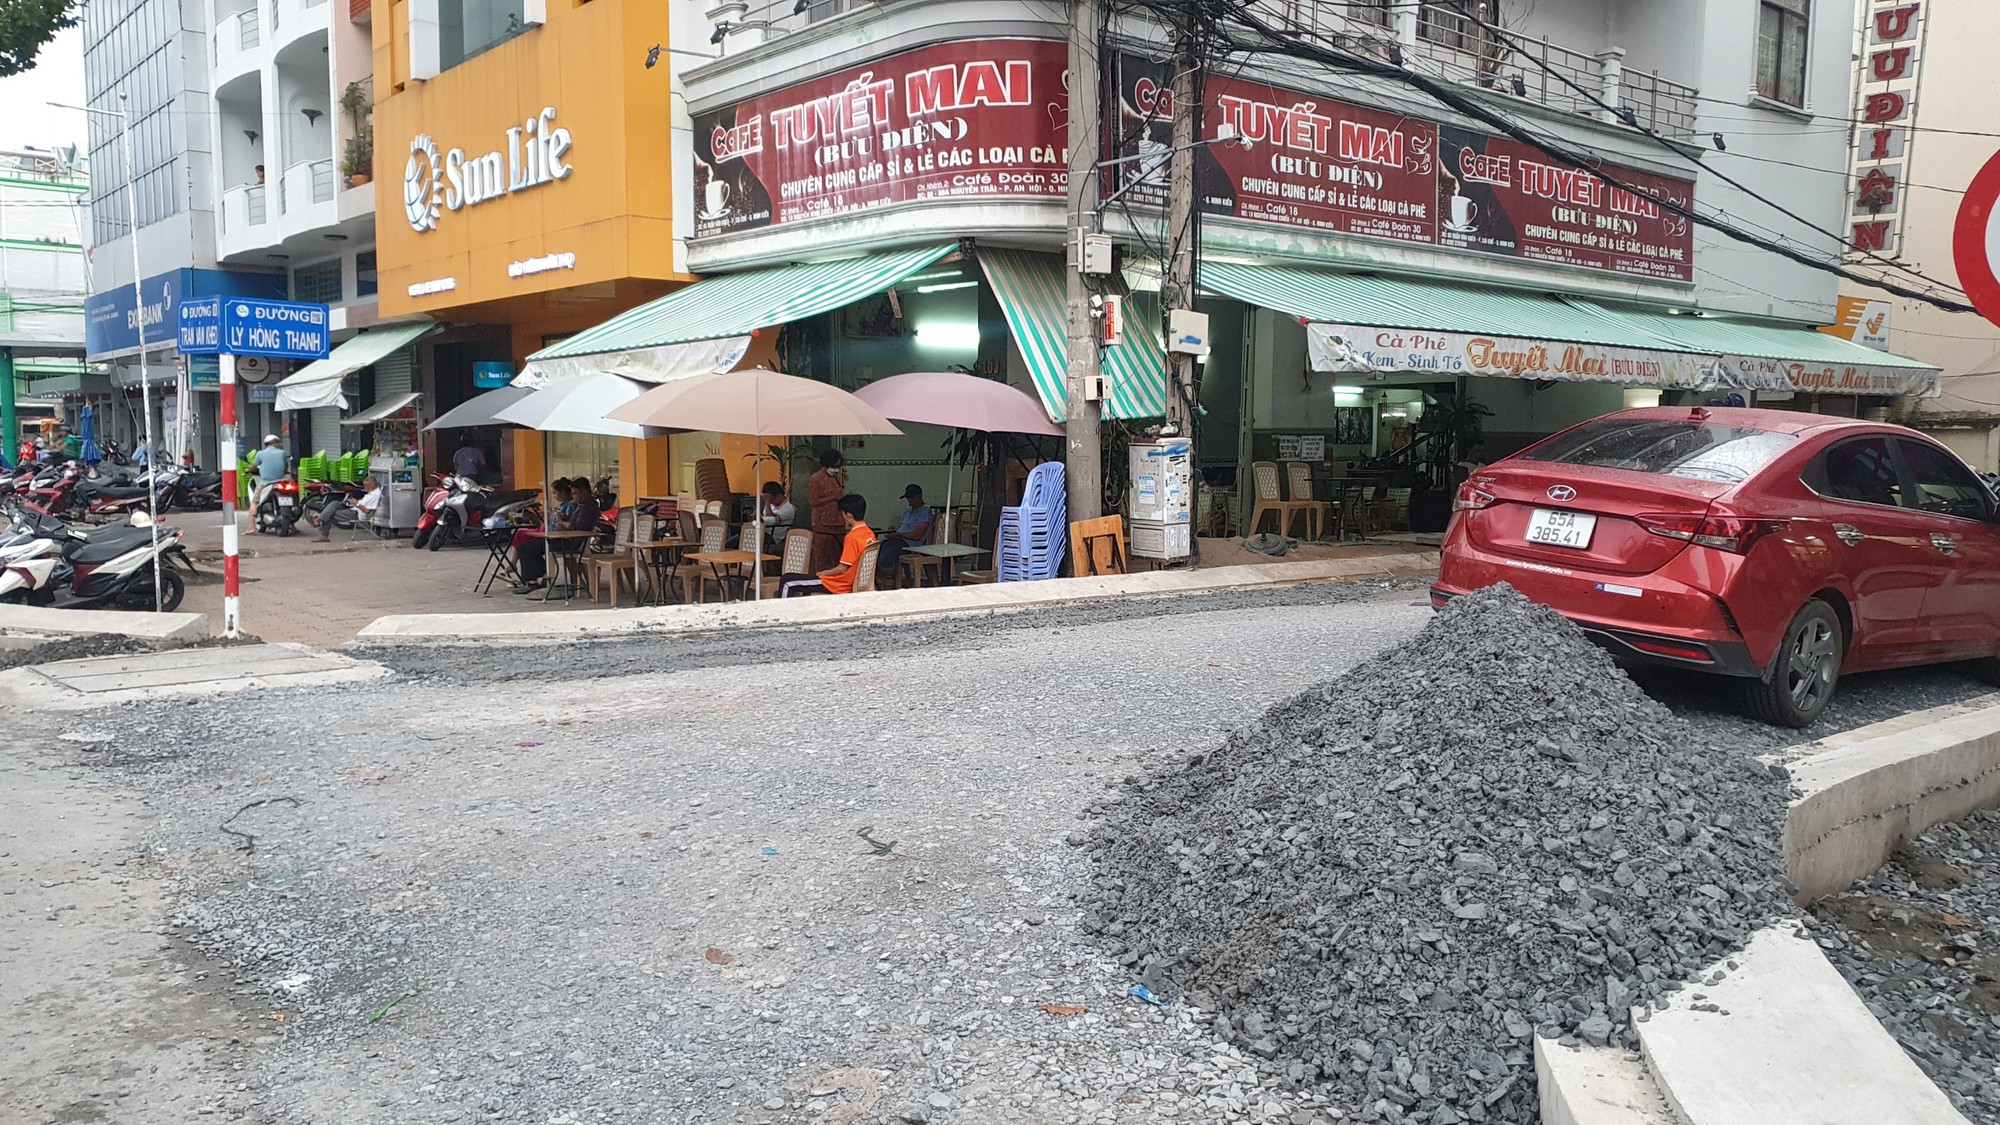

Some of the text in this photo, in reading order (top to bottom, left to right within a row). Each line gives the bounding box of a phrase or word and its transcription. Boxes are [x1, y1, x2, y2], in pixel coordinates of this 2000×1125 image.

[770, 72, 894, 148] TUYẾT
[906, 60, 1032, 117] MAI
[1218, 94, 1331, 154] TUYẾT
[1340, 120, 1403, 168] MAI
[814, 116, 968, 168] (BƯU ĐIỆN)
[446, 106, 573, 211] Sun Life
[781, 173, 822, 198] CHUYÊN
[825, 170, 855, 191] CUNG
[859, 159, 883, 181] CẤP
[887, 155, 900, 177] SỈ
[904, 157, 914, 174] &
[918, 148, 934, 172] LẺ
[937, 147, 973, 168] CÁC
[979, 146, 1023, 167] LOẠI
[1030, 144, 1057, 164] CÀ
[953, 173, 992, 185] Café
[998, 172, 1045, 184] Đoàn
[1050, 174, 1068, 184] 30
[1271, 152, 1383, 191] (BƯU ĐIỆN)
[807, 198, 830, 211] Café
[833, 195, 843, 206] 18
[1242, 176, 1278, 196] CHUYÊN
[1281, 182, 1305, 200] CUNG
[1308, 184, 1325, 204] CẤP
[1339, 192, 1345, 206] &
[1347, 189, 1358, 209] LẺ
[1359, 195, 1376, 213] CÁC
[1378, 200, 1396, 218] LOẠI
[1397, 200, 1409, 217] CÀ
[1411, 200, 1426, 219] PHÊ
[1266, 202, 1286, 215] Café
[1290, 206, 1298, 216] 18
[1372, 218, 1390, 231] Café
[1392, 220, 1412, 233] Đoàn
[1413, 224, 1421, 234] 30
[1552, 205, 1637, 235] (BƯU ĐIỆN)
[1525, 222, 1557, 240] CHUYÊN
[1559, 230, 1581, 244] CUNG
[1582, 231, 1598, 247] CẤP
[1609, 237, 1615, 249] &
[1616, 236, 1625, 251] LẺ
[1627, 240, 1640, 255] CÁC
[1642, 244, 1658, 259] LOẠI
[1659, 244, 1669, 259] CÀ
[1670, 245, 1684, 261] PHÊ
[1545, 245, 1563, 256] Café
[1565, 248, 1572, 257] 18
[1634, 258, 1649, 271] Café
[189, 303, 211, 318] ĐƯỜNG
[255, 304, 310, 322] ĐƯỜNG
[180, 321, 194, 345] TRẦN
[231, 321, 320, 351] LÝ HỒNG THANH
[1375, 333, 1448, 351] Cà Phê
[1363, 351, 1397, 368] Kem
[1407, 353, 1440, 370] Sinh
[1442, 353, 1463, 371] Tố
[1466, 338, 1549, 376] Tuyết
[1552, 344, 1610, 376] Mai
[1740, 360, 1755, 372] Cà
[1788, 363, 1835, 391] Tuyết
[1837, 367, 1870, 389] Mai
[252, 388, 275, 399] ATM
[1548, 511, 1575, 528] 65A
[1532, 526, 1581, 545] 385.41
